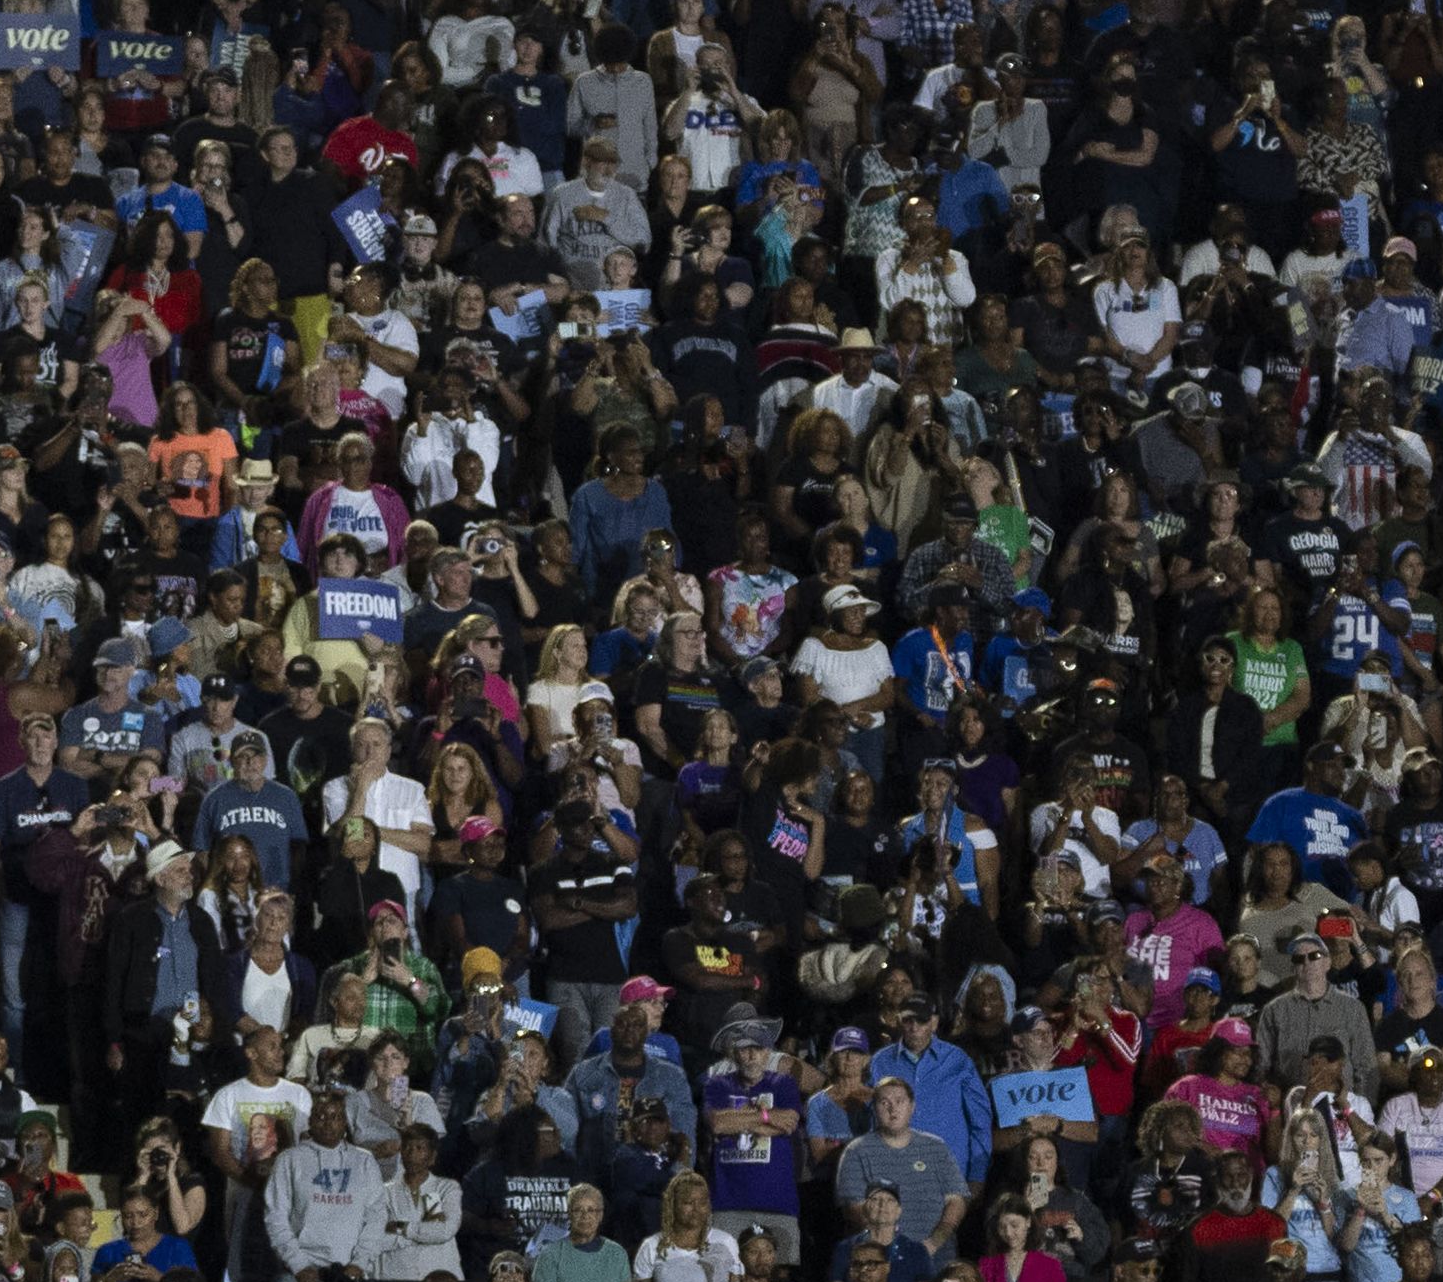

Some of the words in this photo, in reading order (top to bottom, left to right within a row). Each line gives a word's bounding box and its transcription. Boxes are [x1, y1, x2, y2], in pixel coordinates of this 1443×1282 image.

[6, 26, 72, 53] vote
[109, 41, 174, 61] vote
[326, 590, 398, 622] FREEDOM
[1332, 614, 1379, 661] 24
[220, 806, 288, 831] ATHENS
[1007, 1080, 1077, 1106] vote
[1199, 1093, 1257, 1117] HARRIS
[1201, 1106, 1240, 1126] WALZ
[311, 1168, 352, 1194] 47
[312, 1192, 354, 1206] HARRIS
